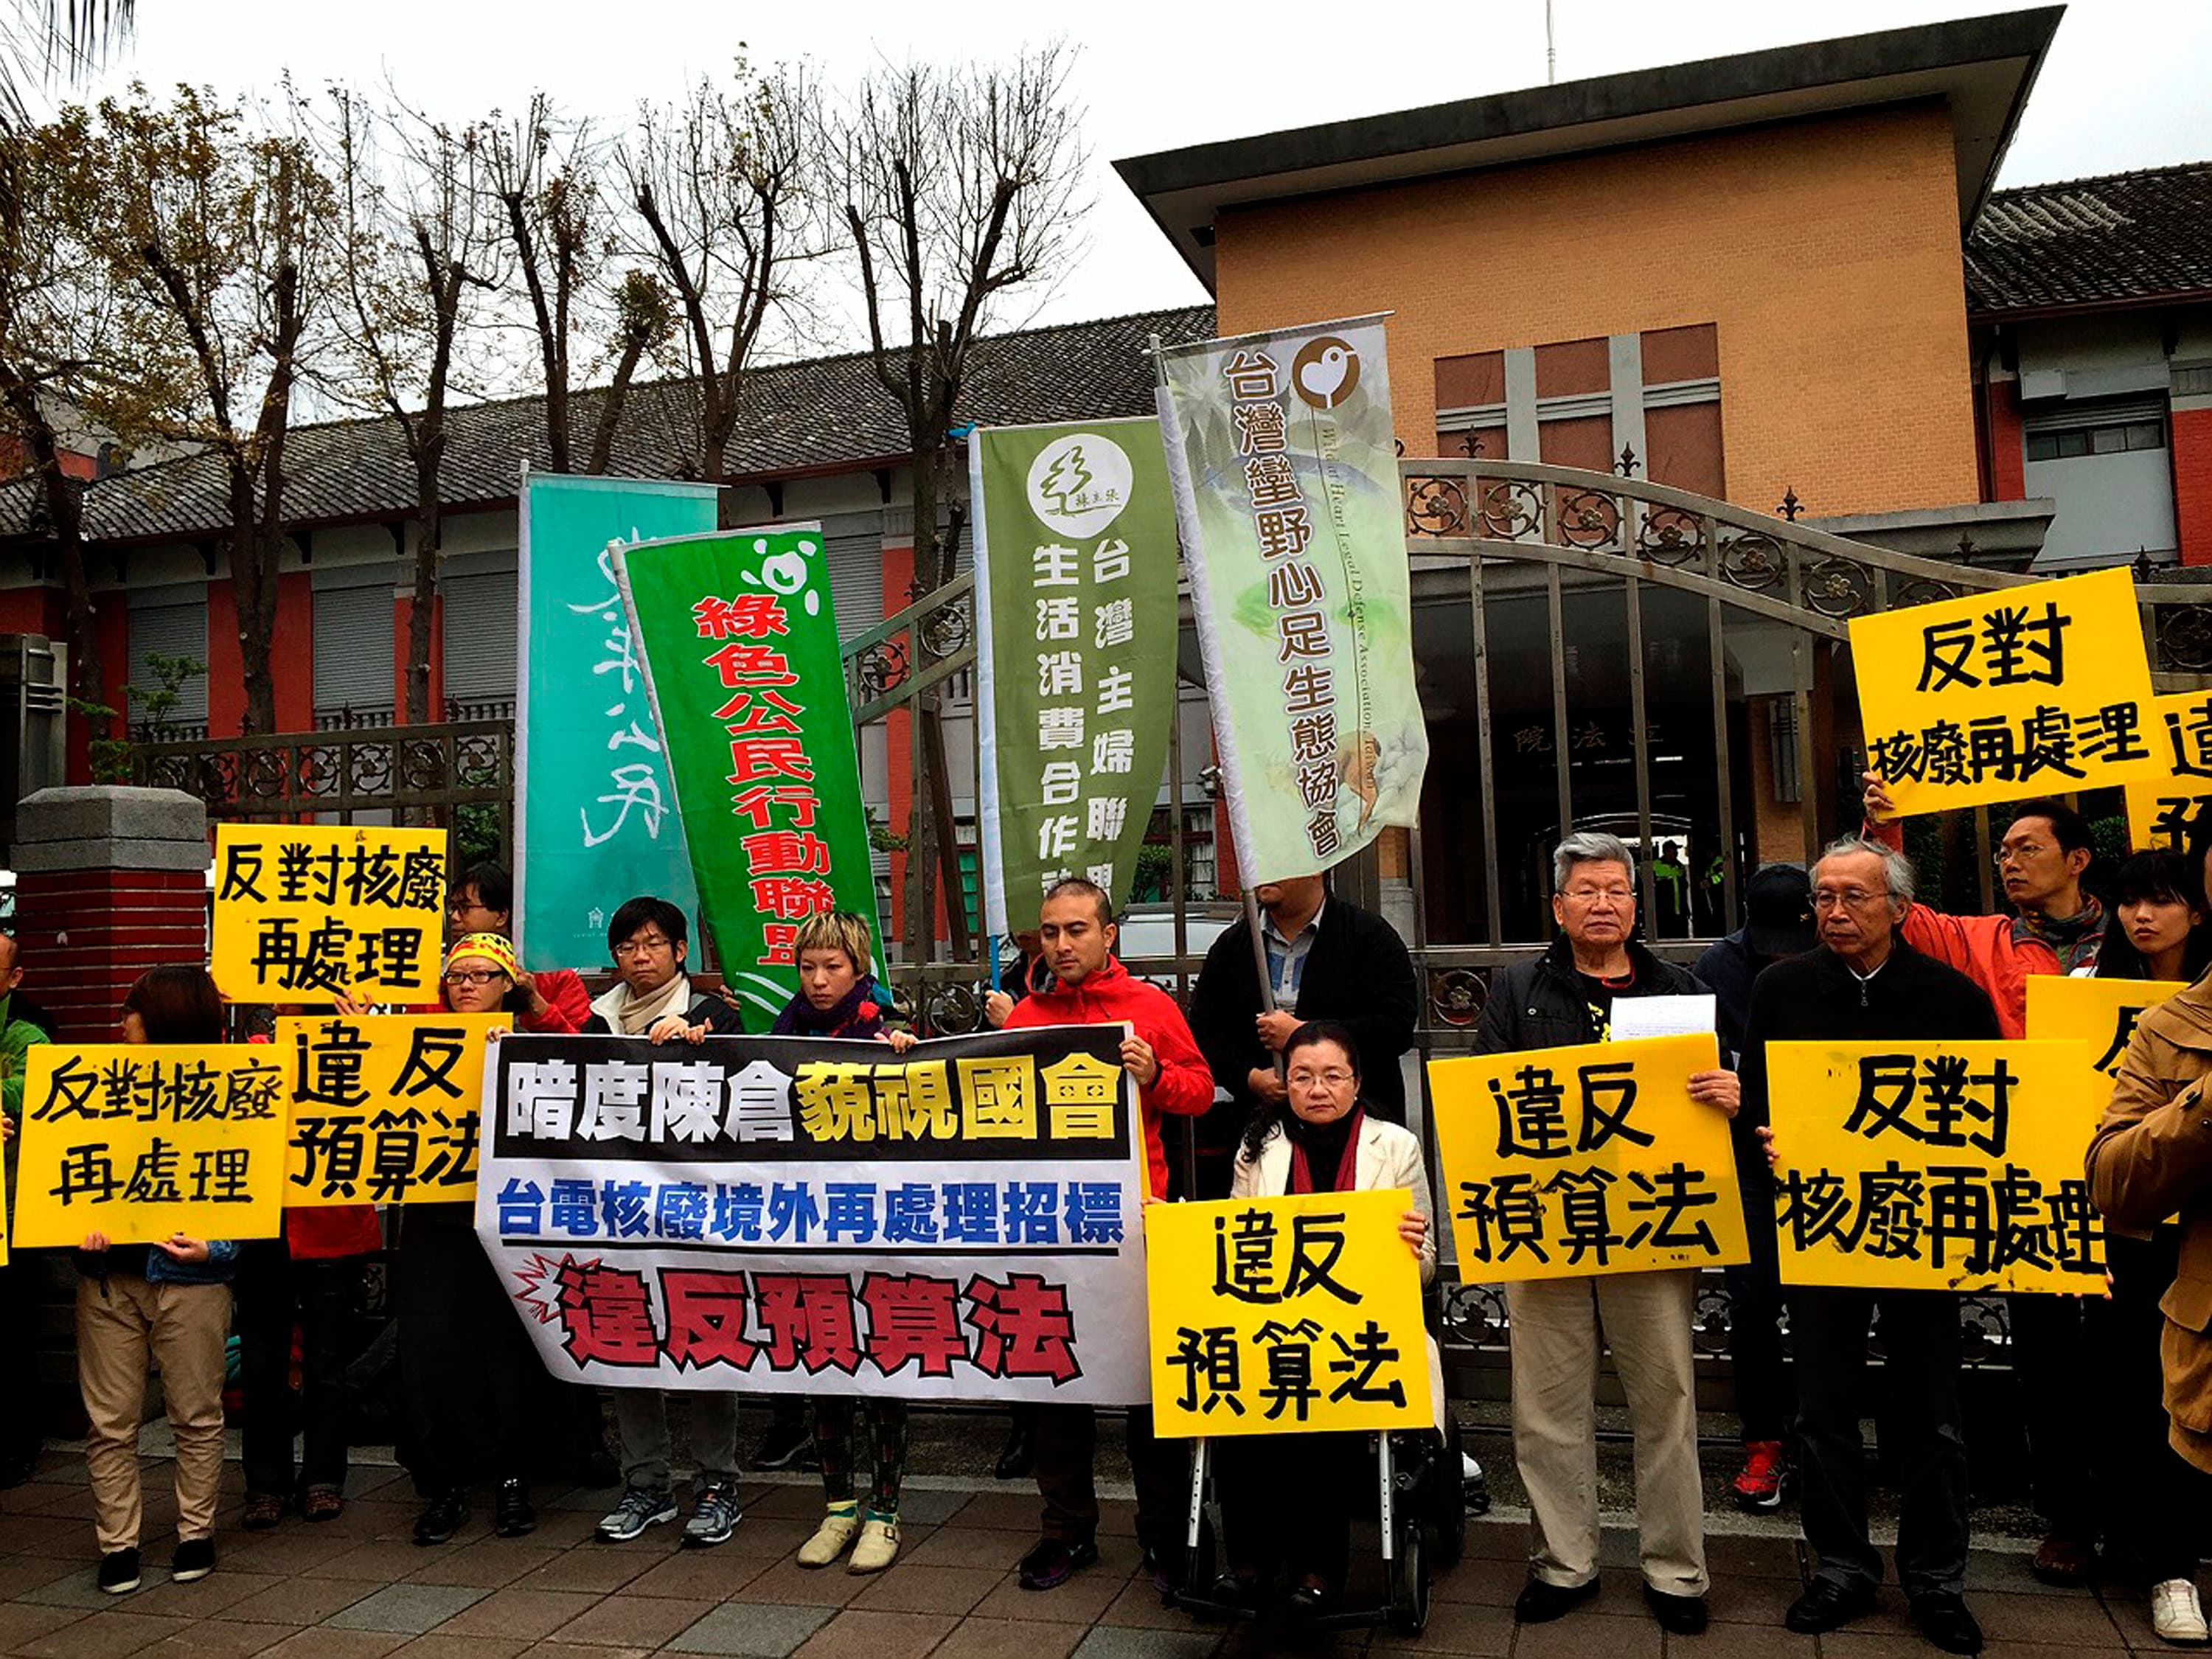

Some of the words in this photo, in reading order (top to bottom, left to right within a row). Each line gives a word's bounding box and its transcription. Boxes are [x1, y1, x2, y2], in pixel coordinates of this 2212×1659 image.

[1224, 351, 1340, 857] 台灣蠻野心足生態協會
[1352, 580, 1366, 641] Defense
[1916, 602, 2071, 692] 反對
[1868, 701, 2149, 787] 核廢再處理
[219, 842, 445, 913] 反對核廢
[251, 917, 422, 995] 再處理
[31, 1056, 285, 1122] 反對核廢
[291, 1020, 467, 1107] 違反
[1843, 1054, 2019, 1158] 反對
[288, 1107, 479, 1200] 預算法
[1487, 1062, 1655, 1158] 違反
[49, 1137, 253, 1206] 再處理
[497, 1178, 1124, 1242] 台電核廢境外再處理招標
[1456, 1163, 1722, 1266] 預算法
[1211, 1207, 1363, 1304] 違反
[1775, 1160, 2107, 1276] 核廢再處理
[556, 1265, 1084, 1387] 違反預算法
[1166, 1318, 1407, 1421] 預算法
